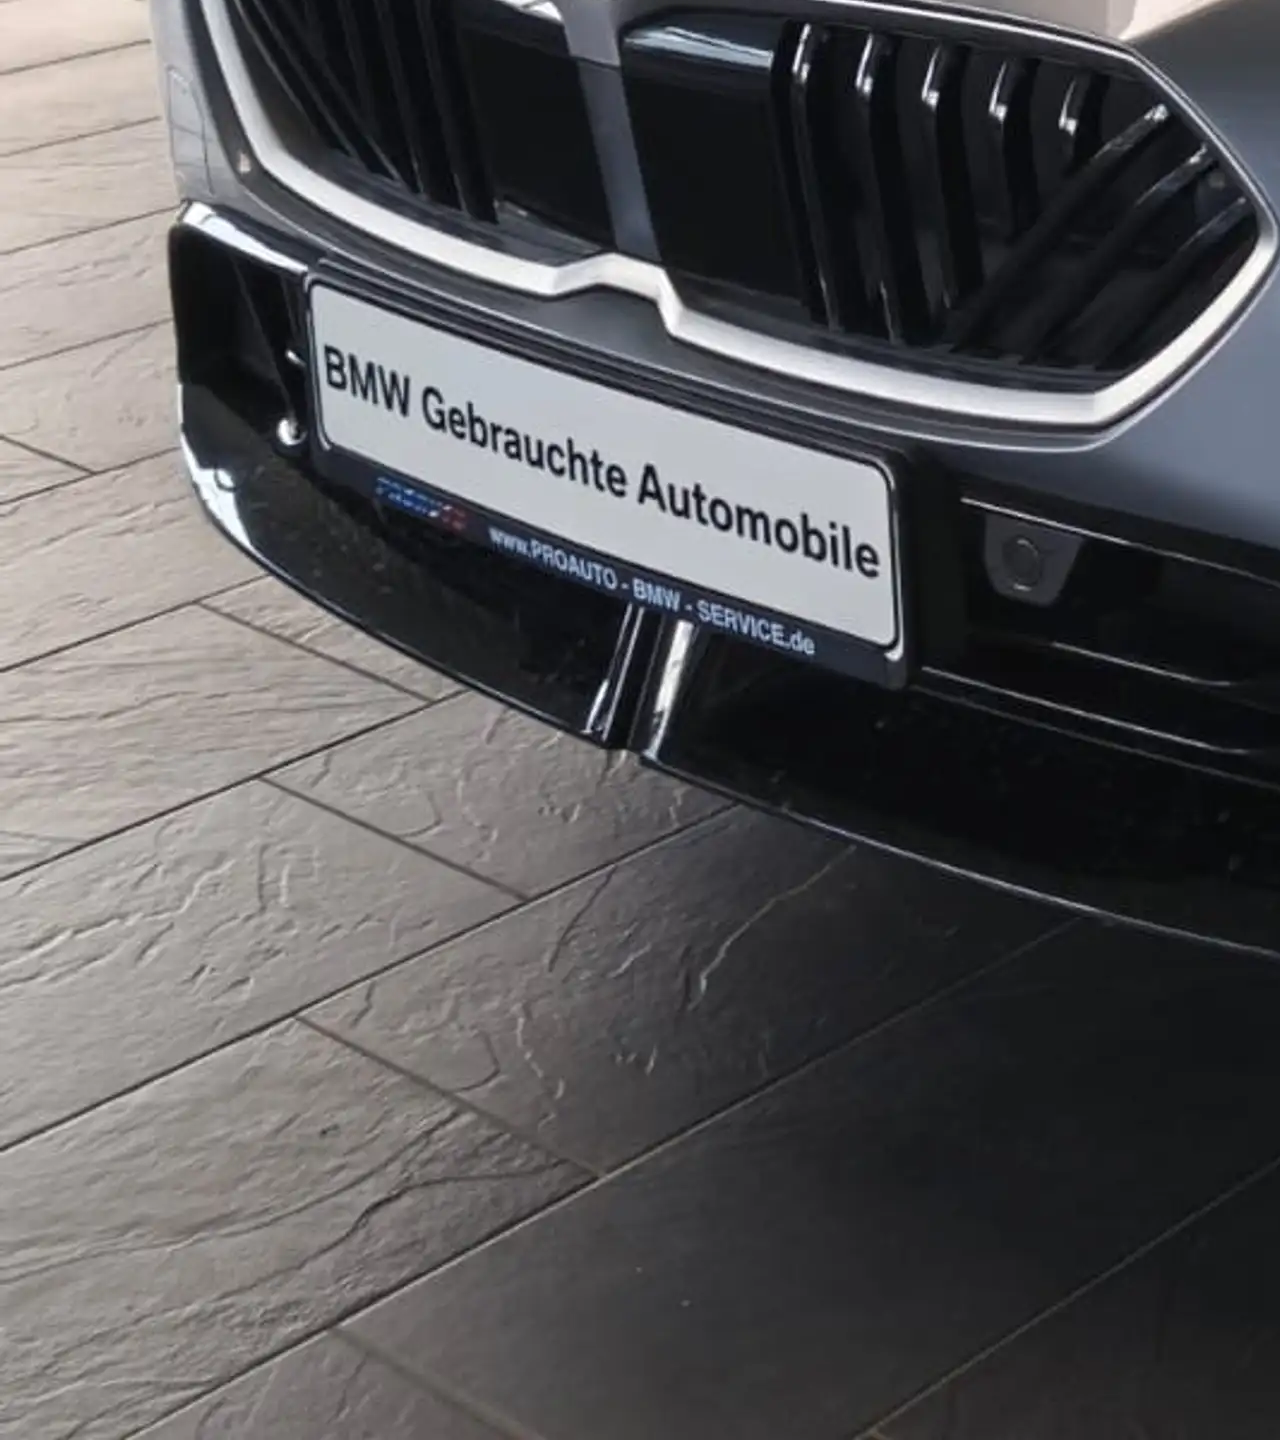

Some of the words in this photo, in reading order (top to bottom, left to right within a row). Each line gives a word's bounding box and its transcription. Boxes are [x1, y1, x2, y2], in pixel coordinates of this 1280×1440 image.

[324, 344, 410, 417] BMW
[422, 386, 627, 497] Gebrauchte
[638, 463, 880, 578] Automobile
[488, 527, 618, 590] www.PROAUTO
[633, 578, 681, 612] BMW
[697, 599, 816, 655] SERVICE.de
